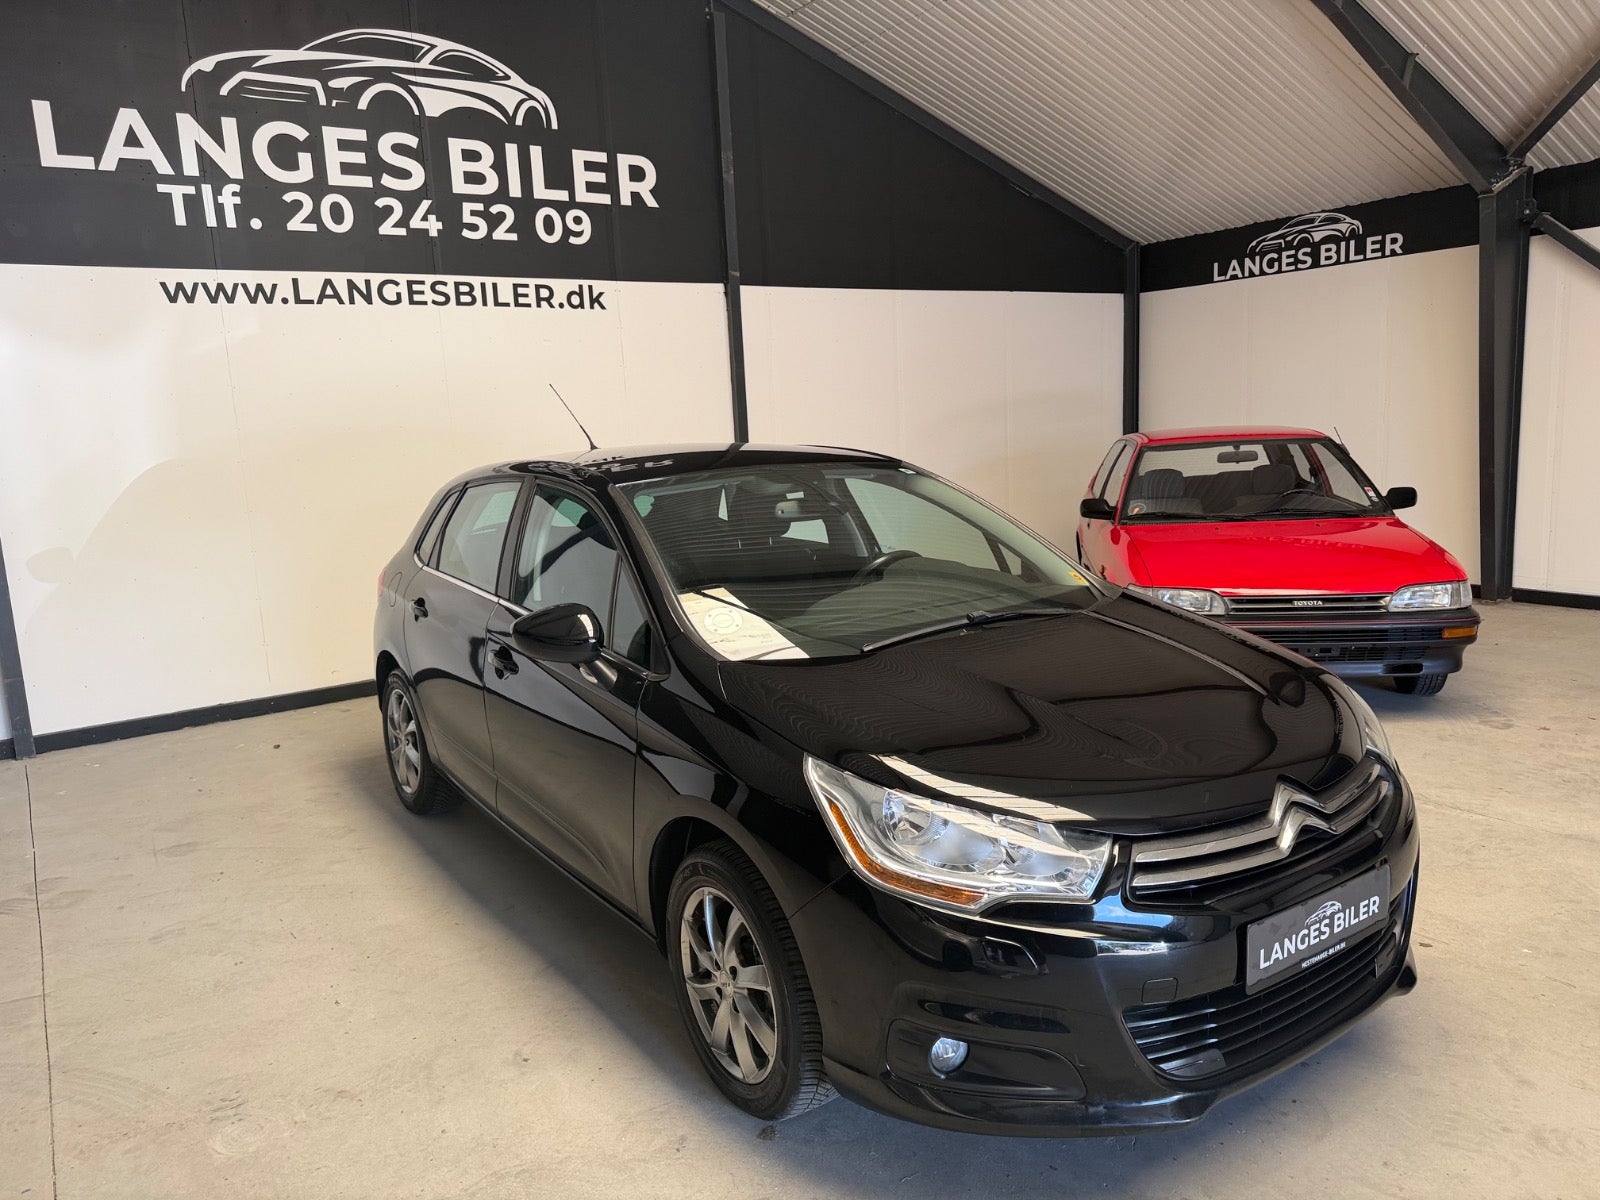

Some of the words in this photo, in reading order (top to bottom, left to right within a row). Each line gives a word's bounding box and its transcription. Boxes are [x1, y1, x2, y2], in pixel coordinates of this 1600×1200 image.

[31, 99, 426, 192] LANGES
[447, 137, 660, 208] BILER
[156, 183, 264, 230] Tlf.
[281, 191, 354, 234] 20
[374, 197, 443, 237] 24
[461, 202, 518, 241] 52
[534, 206, 592, 245] 09
[1213, 247, 1313, 282] LANGES
[1319, 232, 1404, 266] BILER
[159, 277, 607, 310] www.LANGESBILER.dk
[1259, 918, 1330, 970] LANGES
[1333, 895, 1380, 934] BILER
